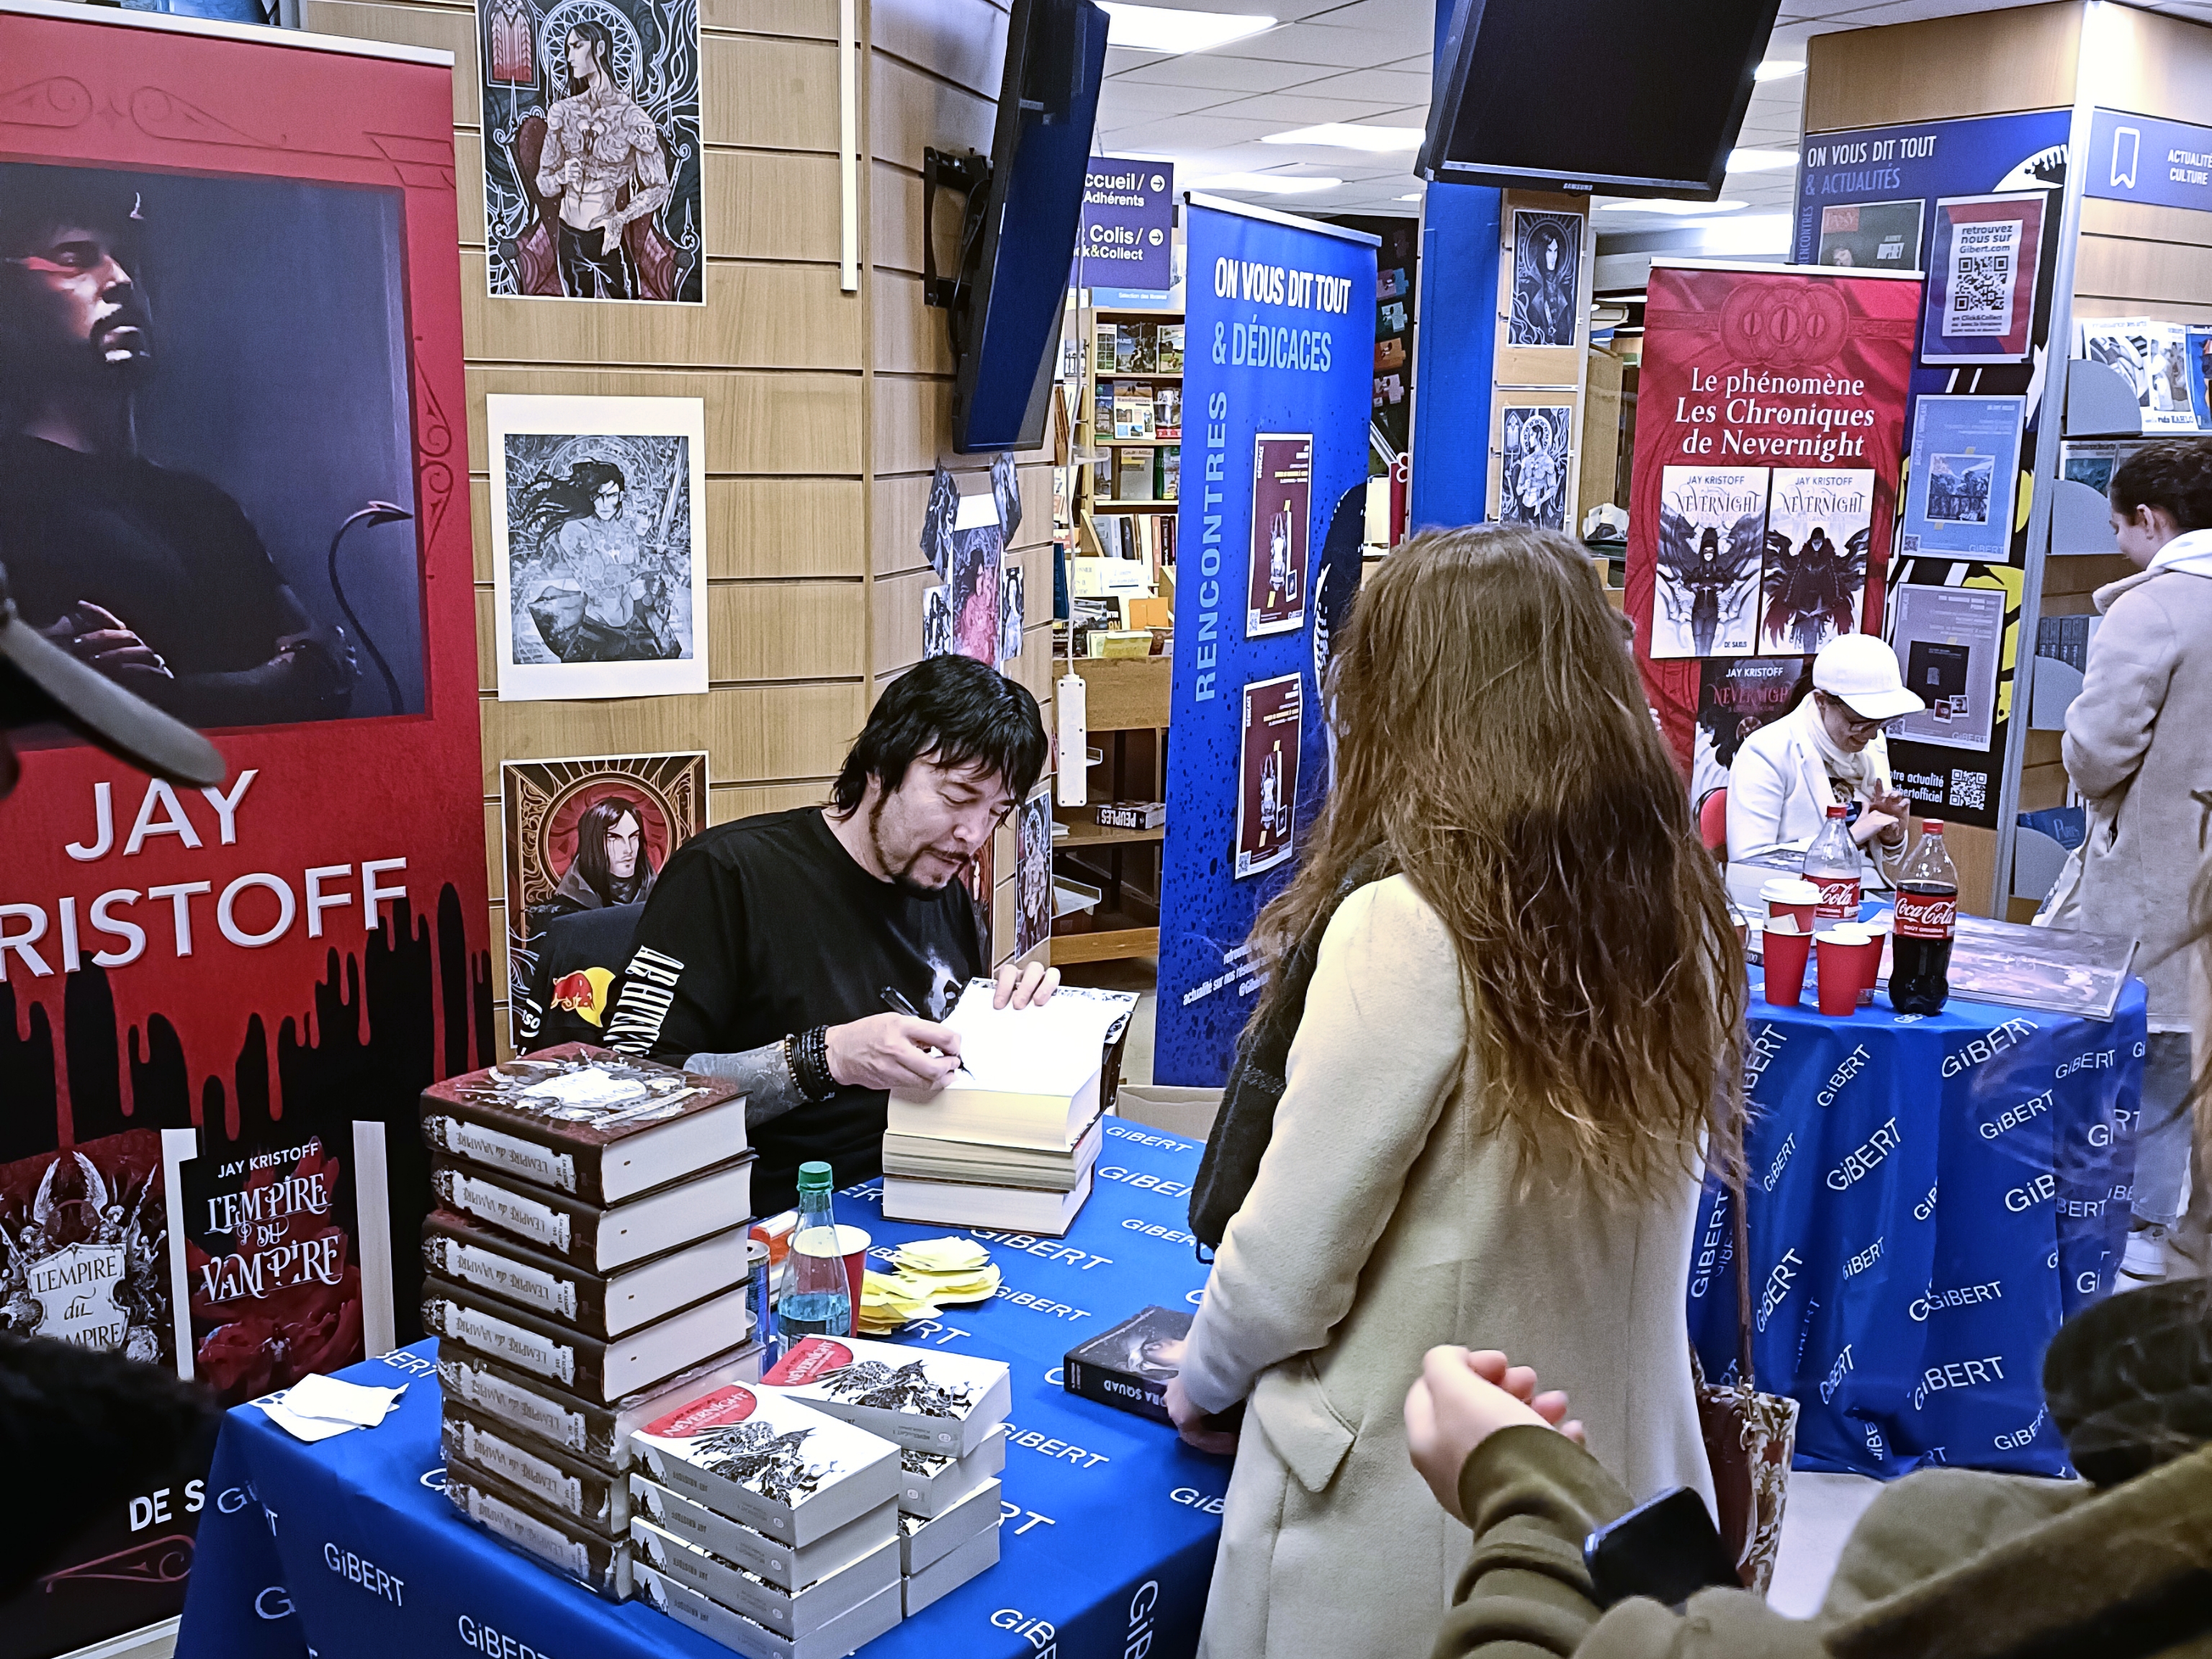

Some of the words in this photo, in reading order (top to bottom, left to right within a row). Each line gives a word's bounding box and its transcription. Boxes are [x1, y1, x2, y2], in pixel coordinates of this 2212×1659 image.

[1808, 148, 1827, 167] ON
[1832, 143, 1867, 165] VOUS
[1873, 140, 1896, 160] DIT
[1899, 135, 1937, 158] TOUT
[1084, 173, 1145, 191] ccueil/
[1805, 174, 1816, 196] &
[1821, 163, 1901, 194] ACTUALITÉS
[2170, 167, 2208, 186] CULTURE
[1083, 190, 1145, 207] Adhérents
[1961, 225, 2013, 235] retrouvez
[1961, 235, 1990, 244] nous
[1992, 234, 2013, 243] sur
[1959, 245, 2010, 254] Gibert.com
[1215, 257, 1239, 299] ON
[1241, 261, 1285, 307] VOUS
[1287, 269, 1311, 310] DIT
[1315, 274, 1352, 314] TOUT
[1212, 320, 1227, 366] &
[1232, 314, 1332, 373] DÉDICACES
[1691, 367, 1718, 392] Le
[1725, 368, 1865, 400] phénomène
[1676, 396, 1717, 423] Les
[1726, 397, 1875, 433] Chroniques
[1682, 428, 1713, 455] de
[1720, 428, 1864, 463] Nevernight
[1686, 475, 1702, 485] JAY
[1704, 475, 1745, 485] KRISTOFF
[1795, 477, 1811, 486] JAY
[1812, 476, 1853, 486] KRISTOFF
[1669, 488, 1762, 516] NEVERNIGHT
[1776, 488, 1866, 516] NEVERNIGHT
[1195, 391, 1228, 703] RENCONTRES
[1726, 667, 1743, 678] JAY
[1744, 667, 1784, 677] KRISTOFF
[1709, 683, 1789, 706] NEVERNIGH
[1907, 771, 1944, 788] actualité
[65, 769, 259, 861] JAY
[1101, 806, 1138, 830] PEUPLES
[0, 856, 407, 982] RISTOFF
[1896, 896, 1956, 926] Coca-Cola
[1183, 978, 1213, 1006] actualité
[1213, 976, 1224, 991] sur
[1224, 969, 1236, 985] nos
[1743, 1023, 1787, 1096] BERT
[1817, 1043, 1871, 1107] GiBERT
[2055, 1048, 2116, 1079] GiBERT
[1979, 1089, 2054, 1140] GiBERT
[456, 1131, 494, 1154] VAMPIRE
[1105, 1125, 1195, 1154] GiBERT
[1827, 1116, 1902, 1191] GiBERT
[217, 1160, 245, 1179] JAY
[249, 1143, 319, 1170] KRISTOFF
[508, 1146, 549, 1174] L'EMPIRE
[1763, 1133, 1797, 1192] GiBERT
[1097, 1165, 1192, 1198] GiBE
[2004, 1173, 2056, 1213] GiB
[204, 1173, 333, 1236] L'EMPIRE
[462, 1186, 497, 1213] VAMPIRE
[2056, 1197, 2108, 1218] BERT
[245, 1218, 285, 1248] DU
[508, 1205, 546, 1233] L'EMPIRE
[1120, 1218, 1207, 1252] GiBER
[970, 1229, 1114, 1271] GiBERT
[1691, 1192, 1728, 1298] GiBERT
[1842, 1236, 1884, 1281] GiBERT
[35, 1253, 120, 1294] L'EMPIRE
[200, 1236, 343, 1306] VAMPIRE
[457, 1254, 495, 1280] VAMPIRE
[508, 1273, 549, 1300] L'EMPIRE
[1756, 1248, 1803, 1334] GiBERT
[1929, 1281, 2002, 1310] GiBERT
[63, 1297, 94, 1321] du
[992, 1284, 1092, 1322] GiBERT
[64, 1322, 122, 1353] MPIRE
[456, 1317, 494, 1341] VAMPIRE
[508, 1336, 547, 1364] L'EMPIRE
[783, 1339, 837, 1387] NEVERNIGHT
[1103, 1379, 1143, 1401] SQUAD
[1913, 1355, 2005, 1411] GiBERT
[661, 1388, 750, 1439] NEVERNIGHT
[998, 1422, 1110, 1469] GiBERT
[129, 1488, 173, 1532] DE
[1169, 1487, 1225, 1514] GiB
[324, 1542, 404, 1606] GiBERT
